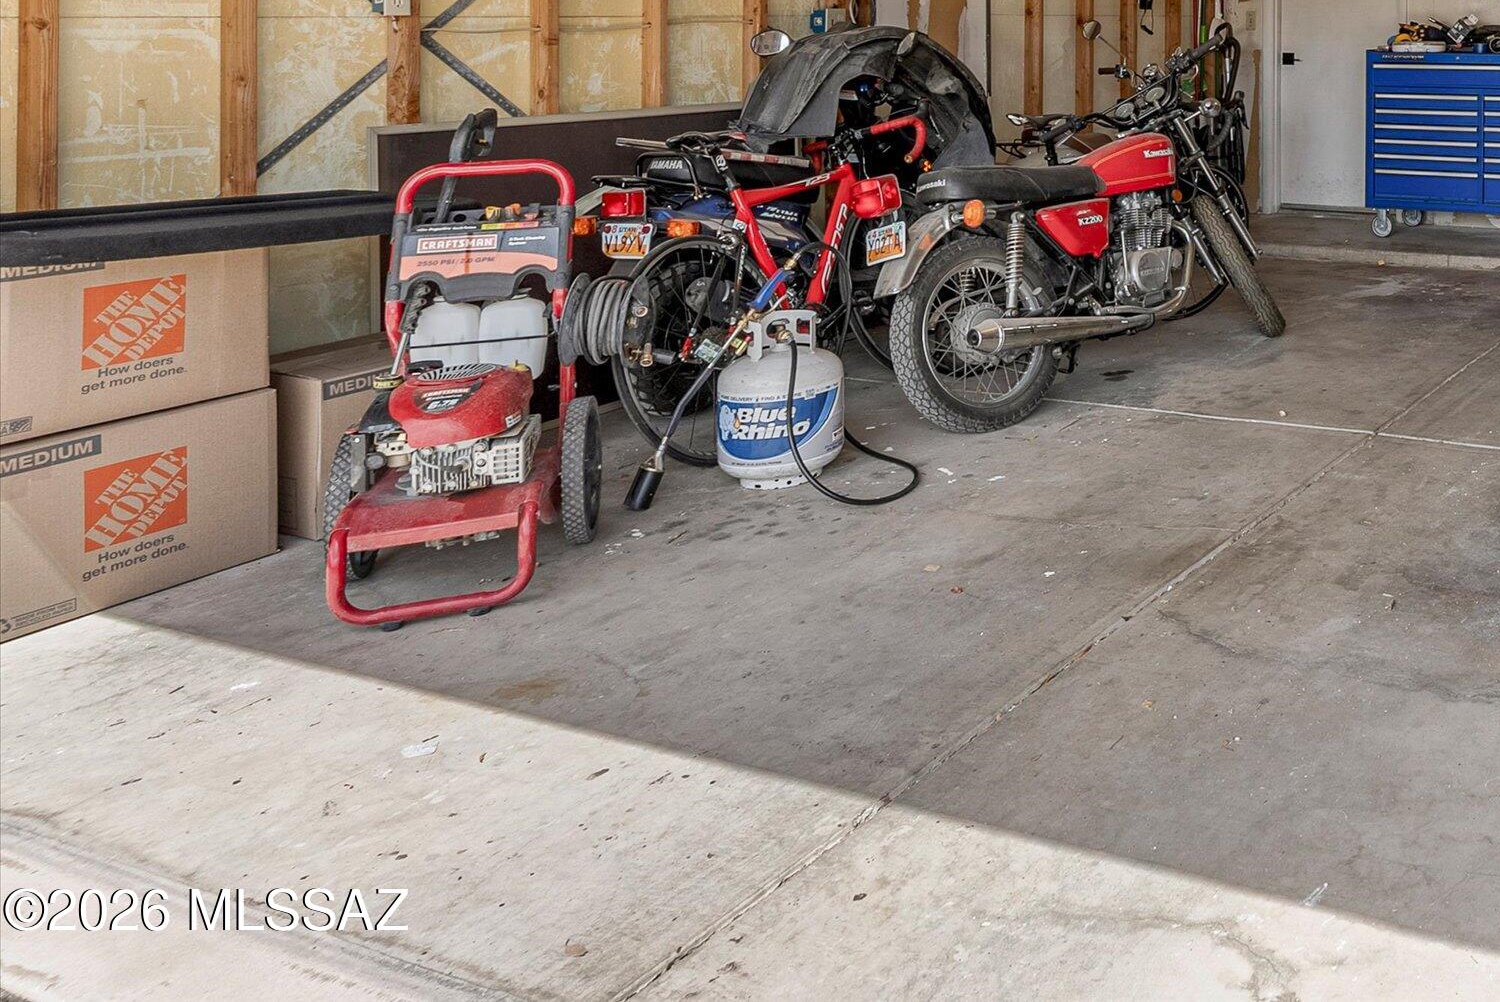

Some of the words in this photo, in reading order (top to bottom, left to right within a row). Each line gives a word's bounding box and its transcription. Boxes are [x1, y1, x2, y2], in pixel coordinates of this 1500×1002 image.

[421, 237, 493, 250] CRAFTSMAN
[82, 276, 186, 366] HOME
[93, 290, 137, 326] THE
[124, 304, 186, 361] DEPOT
[81, 381, 105, 394] get
[109, 374, 146, 388] more
[150, 366, 188, 380] done.
[98, 364, 130, 378] How
[134, 356, 173, 371] doers
[732, 421, 810, 439] Rhino
[737, 407, 797, 423] Blue
[0, 439, 94, 474] MEDIUM
[84, 451, 188, 547] HOME
[95, 468, 138, 505] THE
[126, 476, 188, 538] DEPOT
[82, 567, 107, 582] get
[110, 555, 147, 572] more
[151, 543, 190, 560] done.
[98, 547, 131, 563] How
[134, 534, 175, 551] doers
